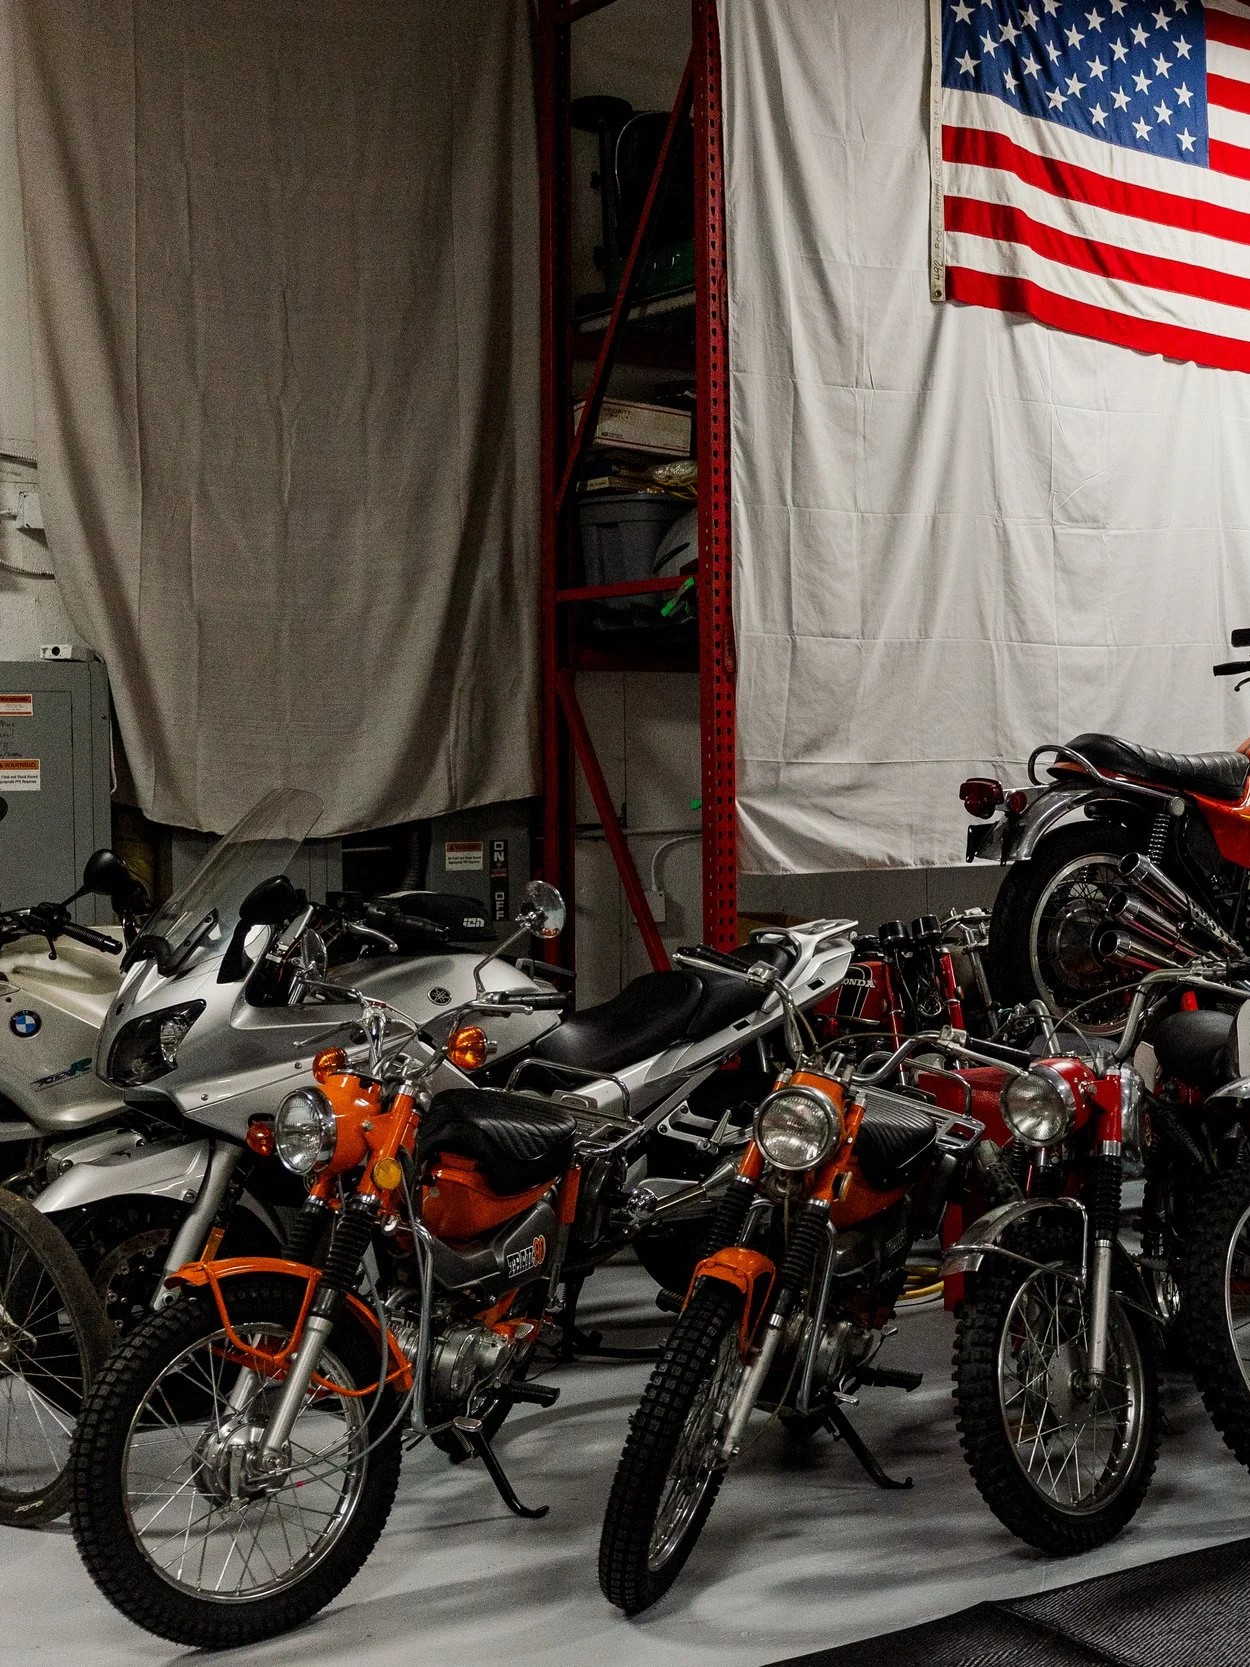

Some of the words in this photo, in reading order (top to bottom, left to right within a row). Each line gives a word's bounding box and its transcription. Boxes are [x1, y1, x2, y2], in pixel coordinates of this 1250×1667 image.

[933, 260, 944, 280] 492
[494, 841, 504, 862] ON
[495, 892, 505, 920] OFF
